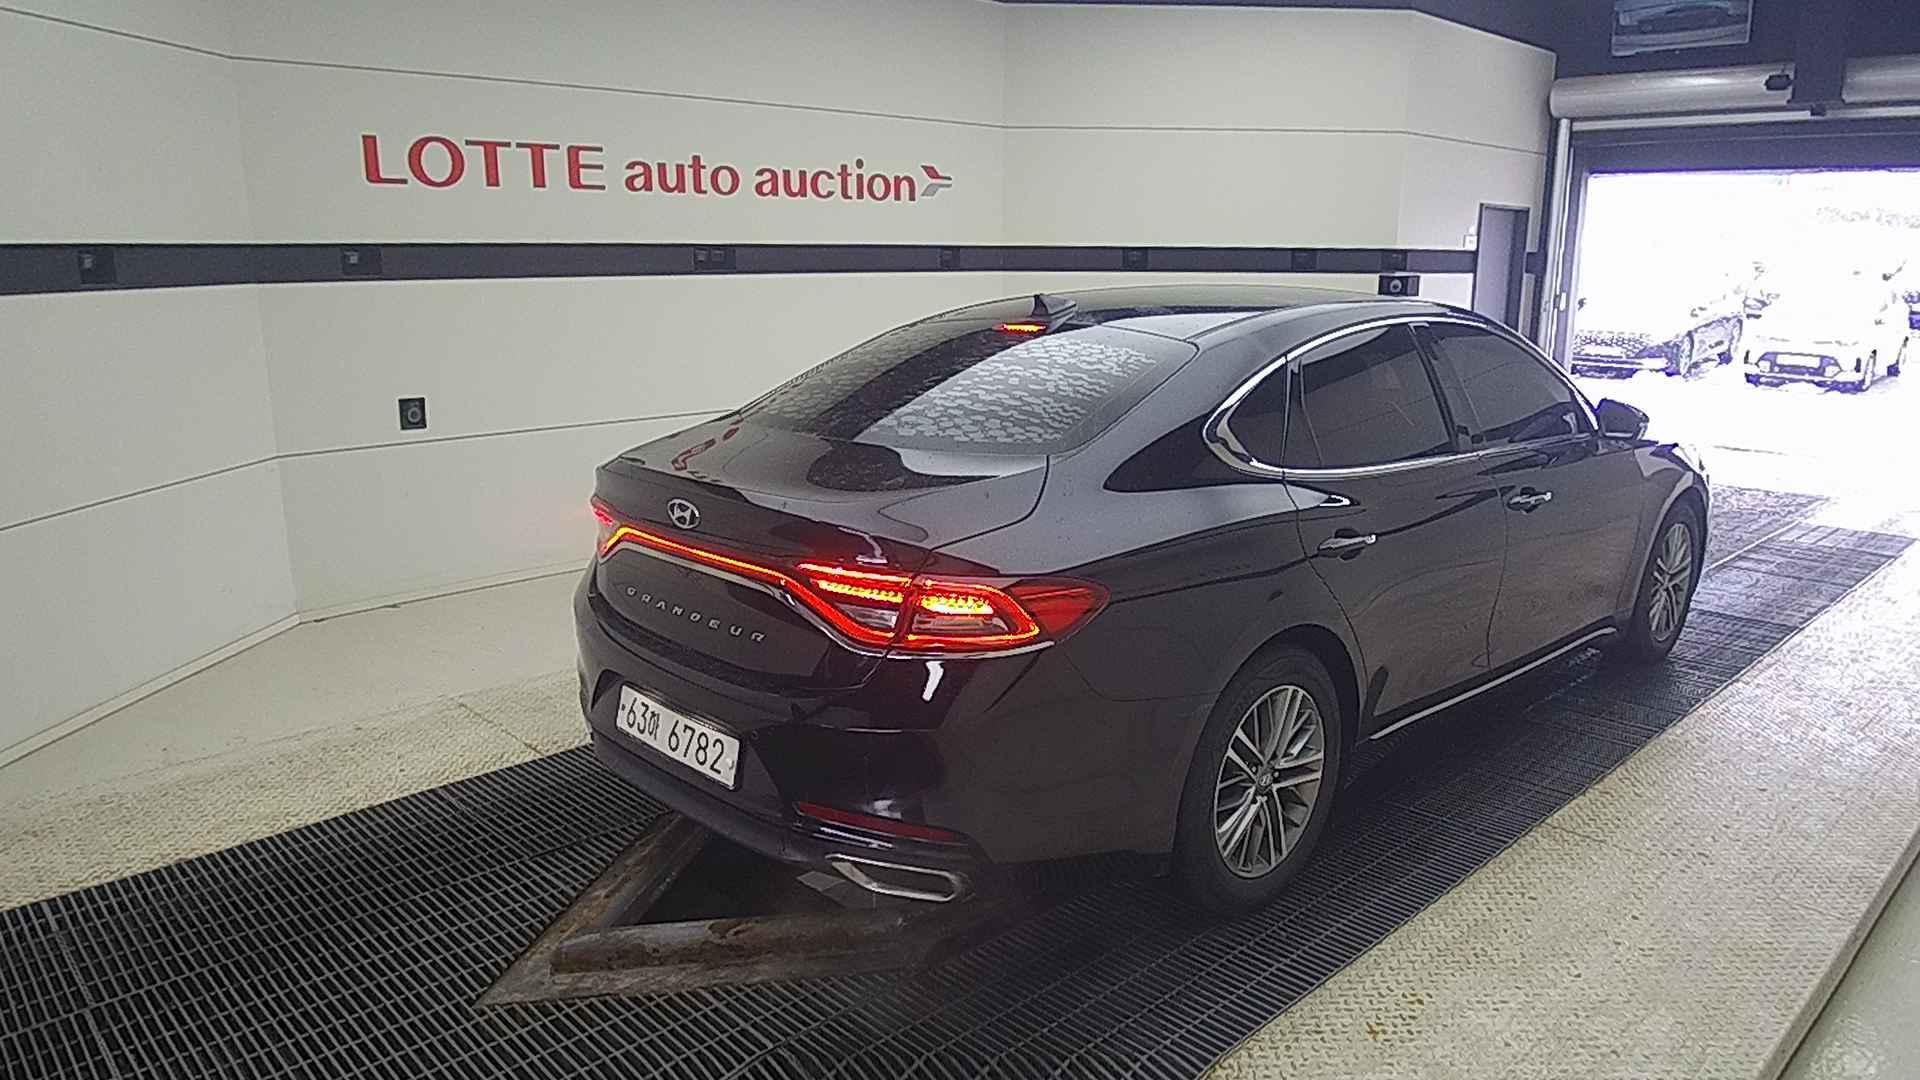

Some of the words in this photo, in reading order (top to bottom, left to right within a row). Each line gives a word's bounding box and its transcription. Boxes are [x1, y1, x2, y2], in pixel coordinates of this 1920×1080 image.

[361, 133, 606, 191] LOTTE
[624, 155, 740, 197] auto
[754, 158, 916, 202] auction
[626, 586, 768, 643] GRANDEUR
[668, 719, 726, 775] 6782
